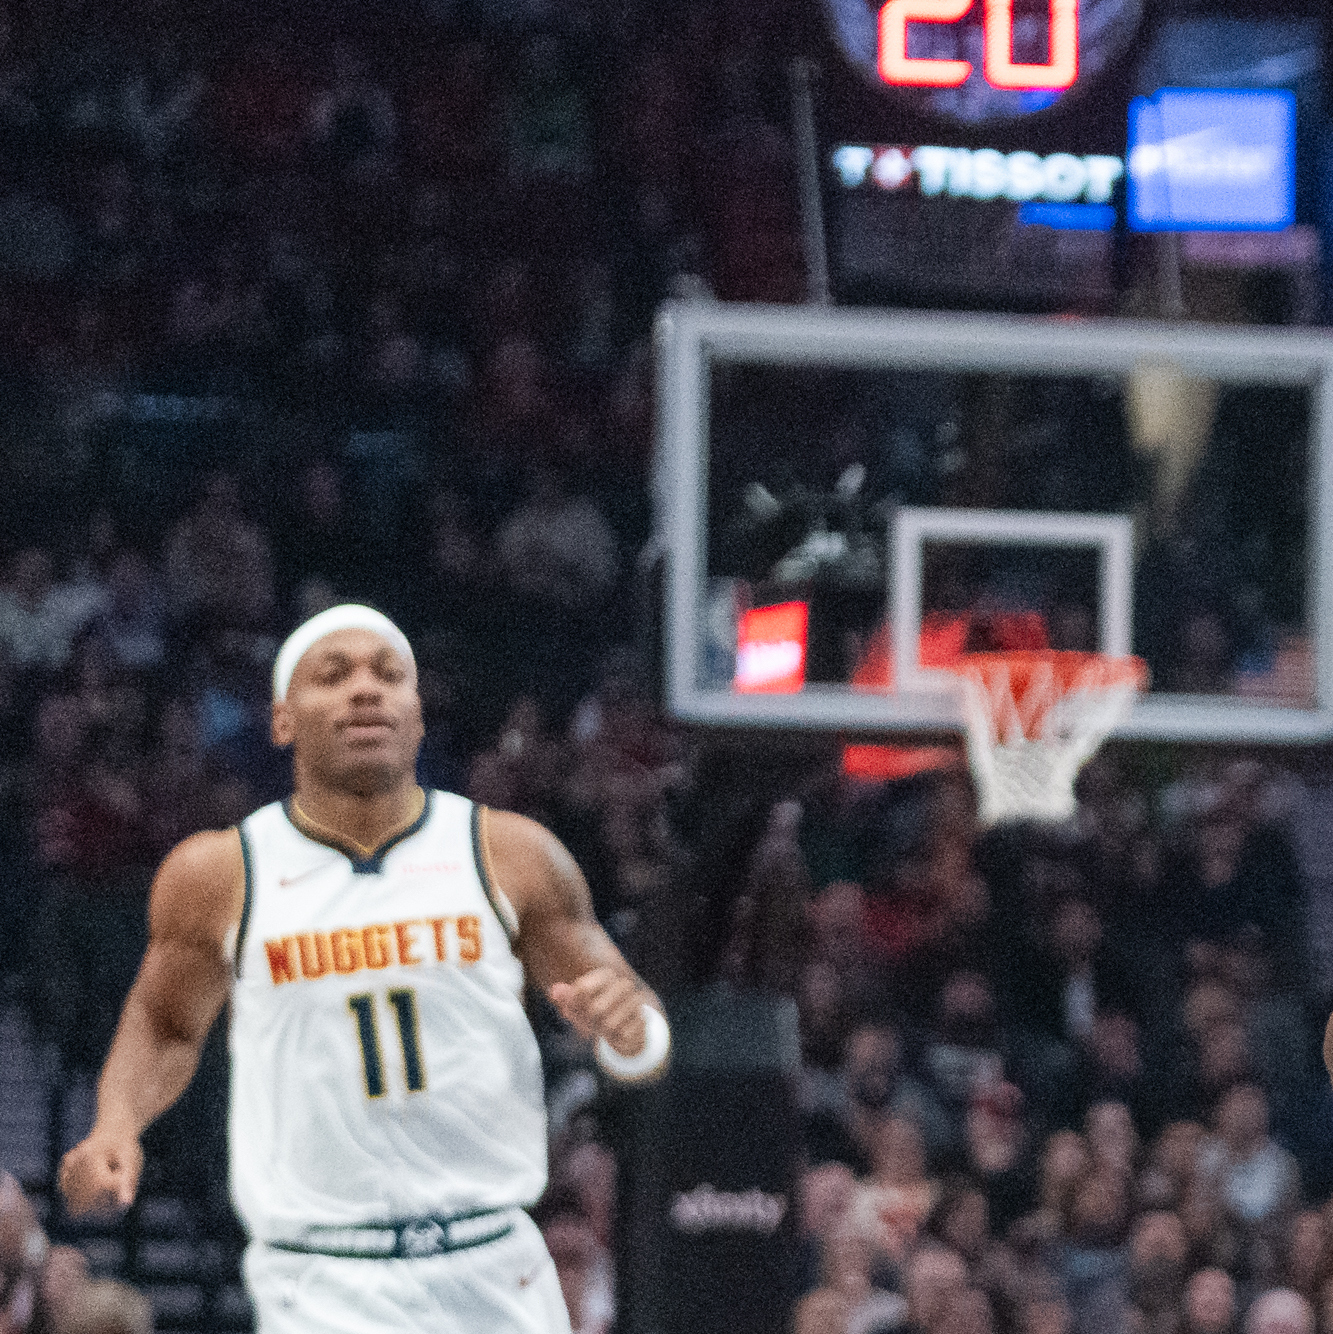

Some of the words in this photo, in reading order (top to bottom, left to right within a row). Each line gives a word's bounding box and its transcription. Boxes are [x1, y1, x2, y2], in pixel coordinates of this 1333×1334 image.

[878, 0, 1079, 90] 20
[914, 145, 1123, 203] TISSOT
[264, 916, 483, 986] NUGGETS
[346, 986, 428, 1098] 11
